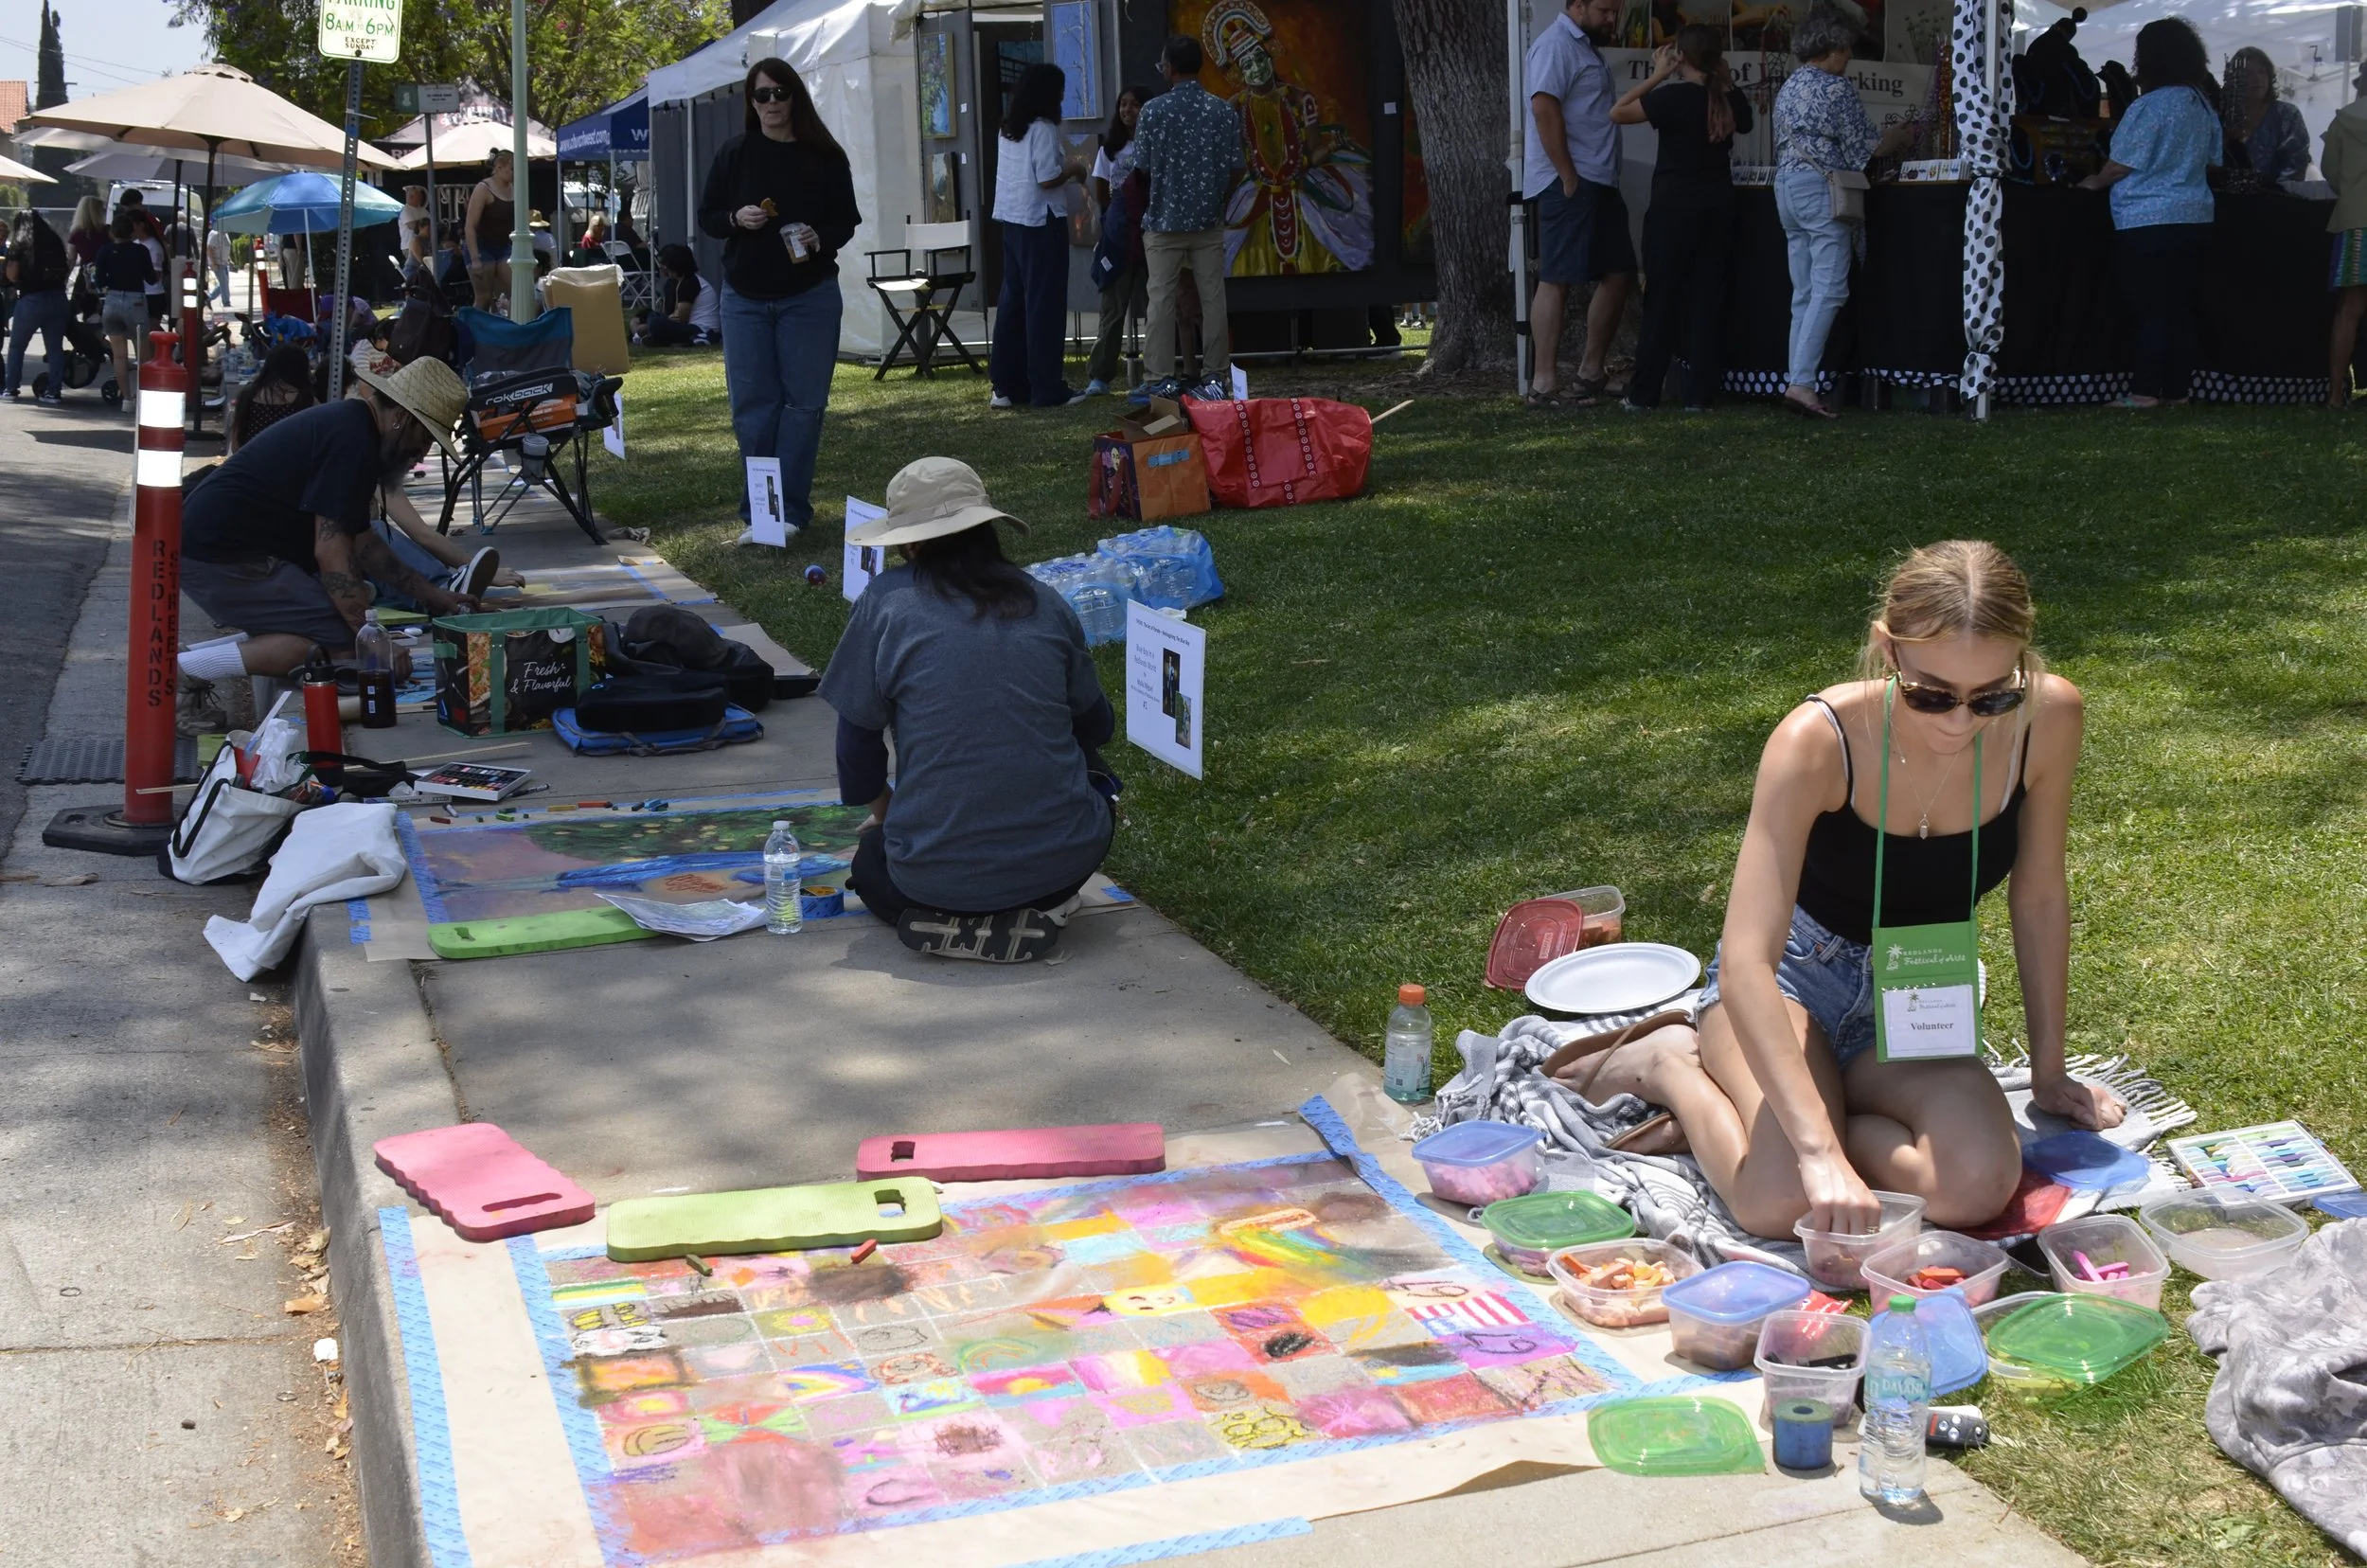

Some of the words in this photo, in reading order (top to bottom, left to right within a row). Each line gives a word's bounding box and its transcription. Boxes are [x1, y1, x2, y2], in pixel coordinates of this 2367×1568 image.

[345, 36, 376, 45] EXCEPT
[345, 43, 375, 51] SUNDAY
[1628, 60, 1656, 80] Th
[486, 383, 554, 405] rokback
[148, 539, 167, 708] REDLANDS
[165, 551, 179, 697] STREETS
[524, 661, 561, 679] Fresh
[509, 678, 519, 694] &
[523, 675, 572, 692] Flavorful
[1903, 954, 1937, 966] Festival
[1945, 954, 1967, 963] Arts
[1911, 1023, 1954, 1031] Volunteer
